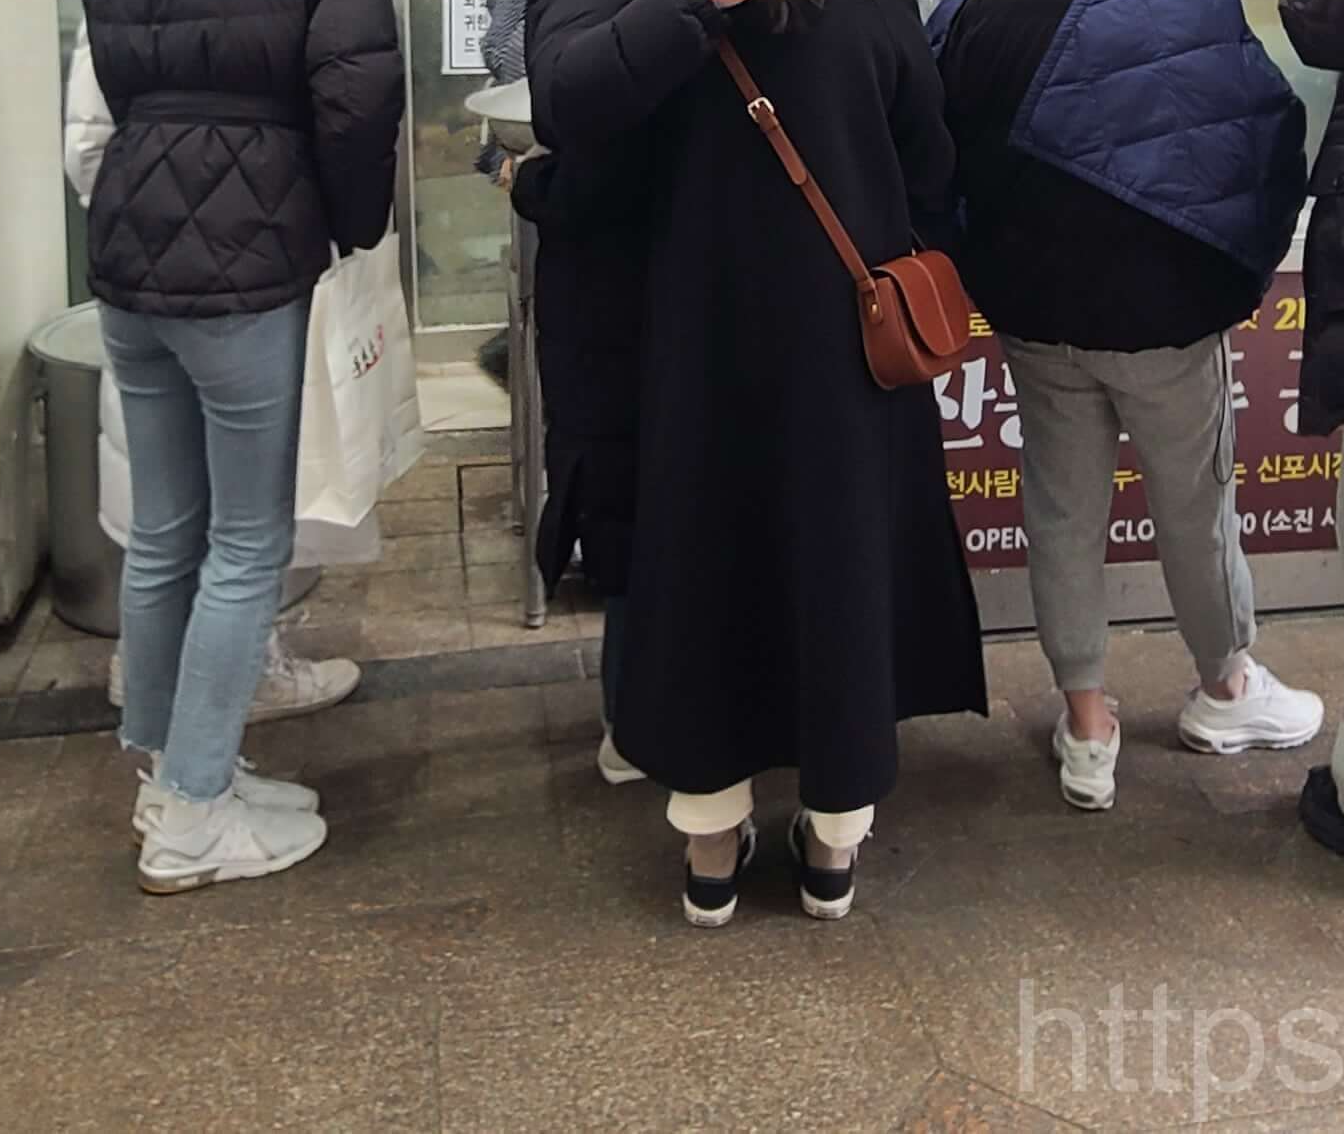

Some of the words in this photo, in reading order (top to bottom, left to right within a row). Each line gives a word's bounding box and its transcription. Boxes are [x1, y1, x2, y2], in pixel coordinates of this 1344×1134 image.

[945, 467, 1021, 500] 천사람
[965, 526, 1030, 552] OPEN
[1109, 518, 1155, 544] CLO
